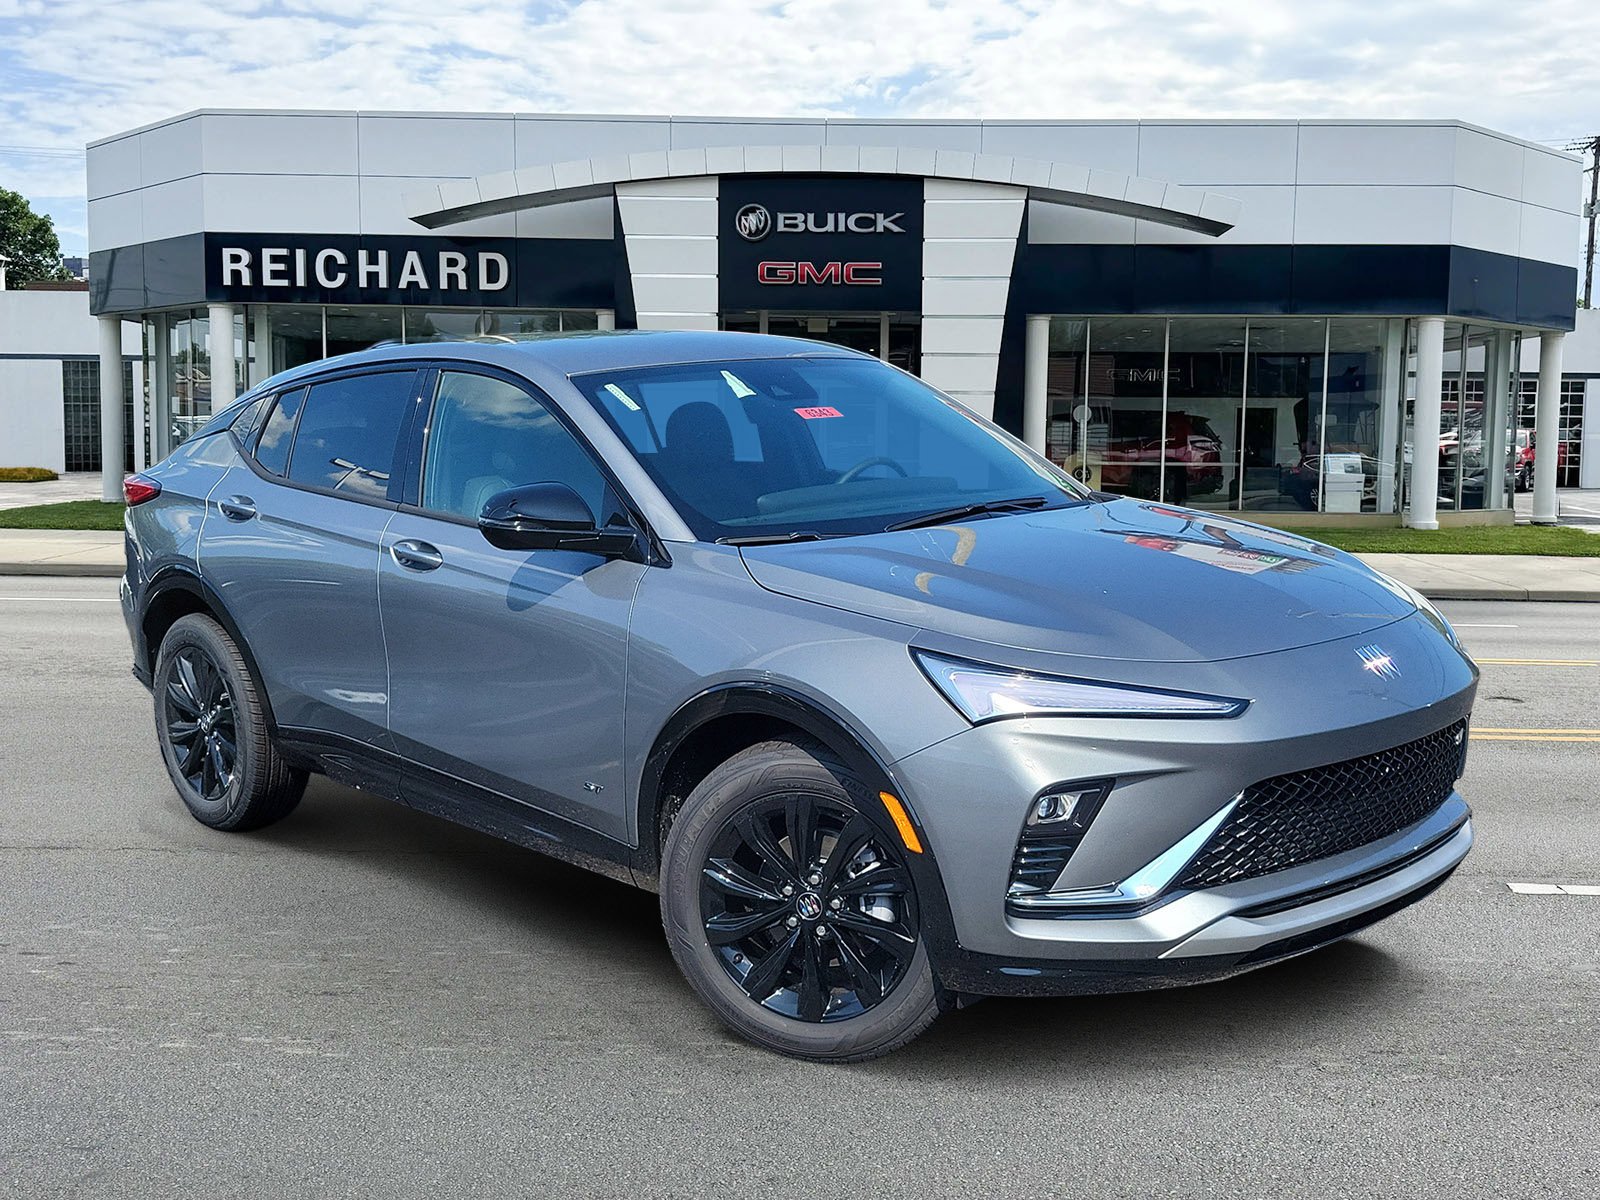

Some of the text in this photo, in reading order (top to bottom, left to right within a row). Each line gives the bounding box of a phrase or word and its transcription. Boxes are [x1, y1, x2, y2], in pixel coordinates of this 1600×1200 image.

[776, 212, 906, 233] BUICK
[222, 247, 510, 291] REICHARD
[758, 261, 882, 285] GMC
[1106, 368, 1181, 382] GMC
[804, 408, 834, 418] 6343
[583, 780, 604, 794] ST
